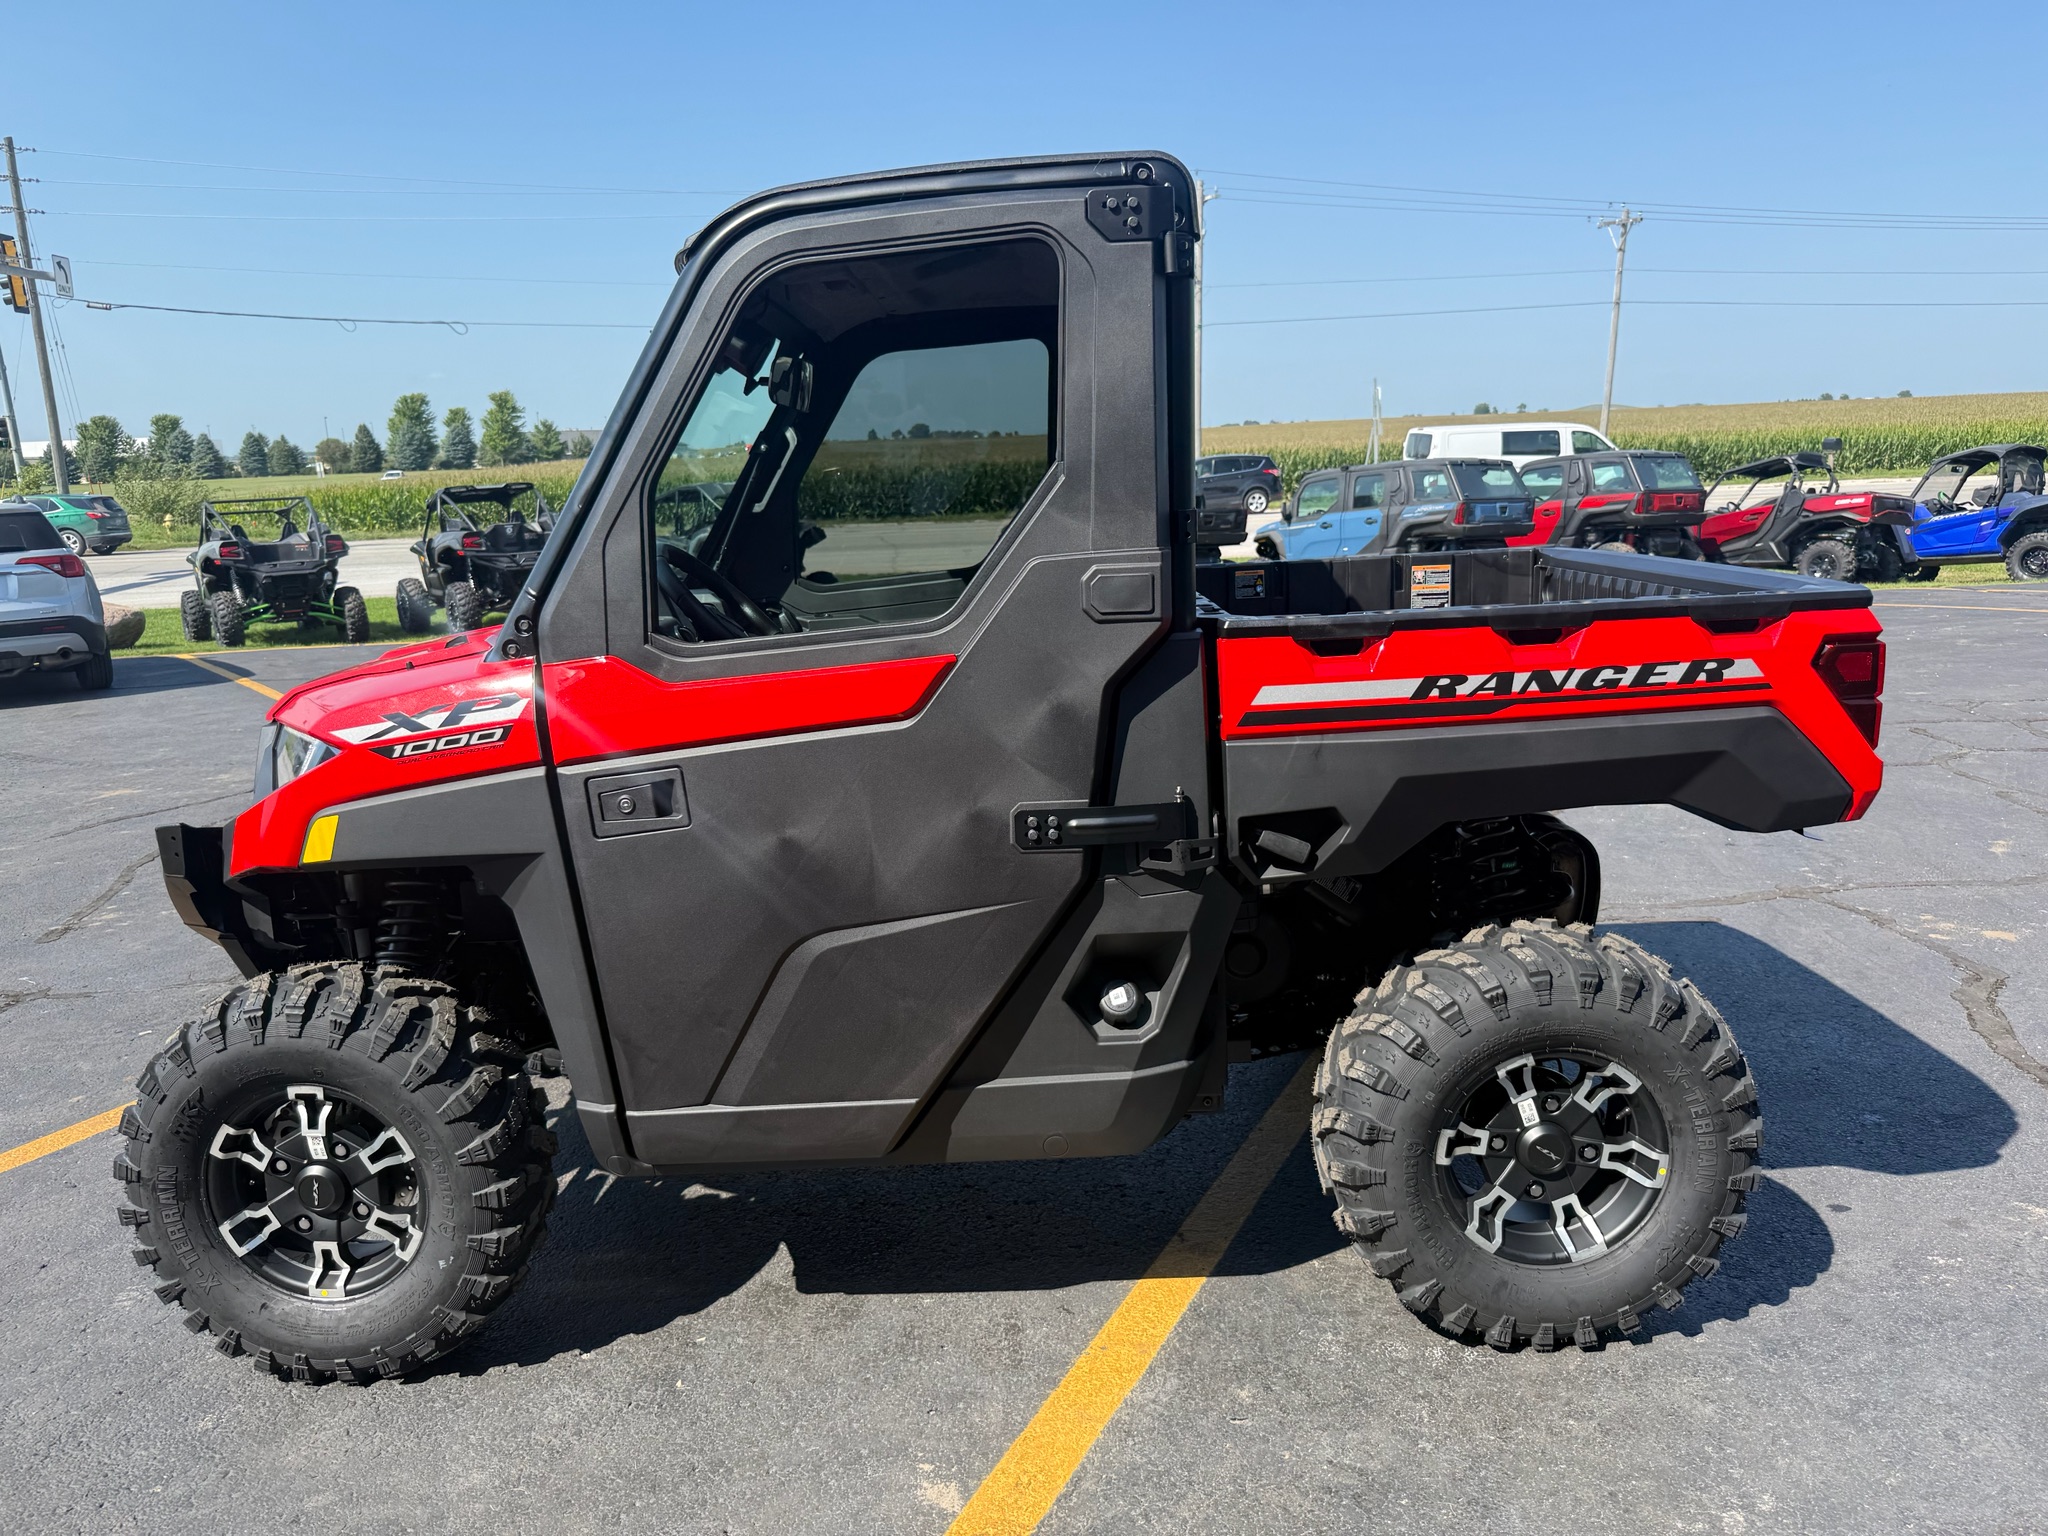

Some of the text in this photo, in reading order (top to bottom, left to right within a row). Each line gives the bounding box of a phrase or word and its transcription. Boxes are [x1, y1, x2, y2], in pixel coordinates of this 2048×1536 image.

[1409, 657, 1736, 700] RANGER
[359, 692, 522, 742] XP
[392, 727, 504, 758] 1000
[1662, 1061, 1718, 1194] X-TERRAIN
[157, 1165, 222, 1295] X-TERRAIN
